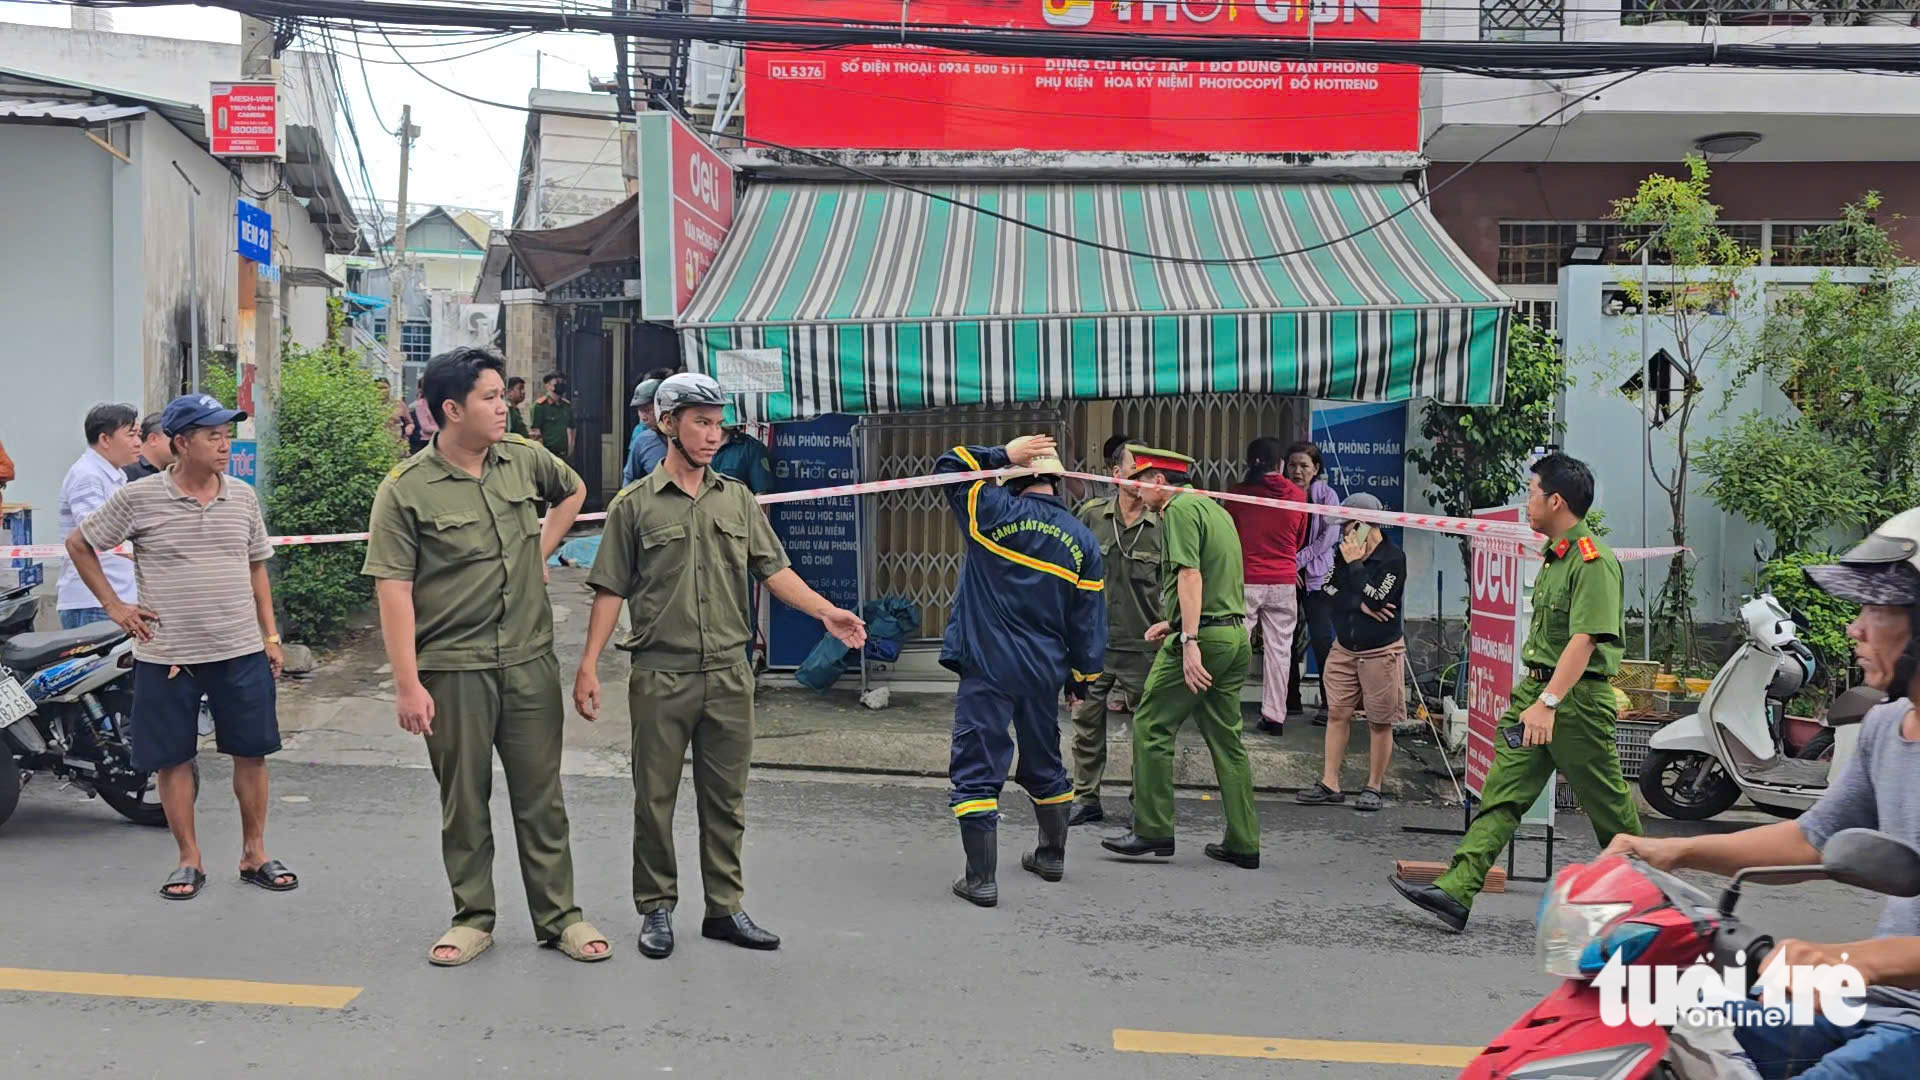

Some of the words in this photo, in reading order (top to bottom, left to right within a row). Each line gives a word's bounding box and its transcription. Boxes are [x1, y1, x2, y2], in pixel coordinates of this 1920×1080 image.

[772, 65, 789, 78] DL
[791, 66, 822, 78] 5376
[841, 57, 859, 73] SỐ
[862, 60, 891, 76] ĐIỆN
[894, 62, 936, 76] THOẠI:
[939, 63, 970, 74] 0934
[974, 64, 997, 74] 500
[1002, 64, 1023, 74] 511
[1036, 76, 1061, 91] PHỤ
[1065, 74, 1093, 91] KIỆN
[1314, 78, 1378, 90] HOTTREND
[690, 152, 719, 212] deli
[776, 432, 796, 447] VĂN
[798, 432, 831, 448] PHÒNG
[1338, 440, 1371, 454] PHÒNG
[1372, 438, 1400, 455] PHẨM
[231, 448, 255, 476] TÓC
[836, 511, 855, 521] SINH
[814, 555, 833, 565] CHƠI
